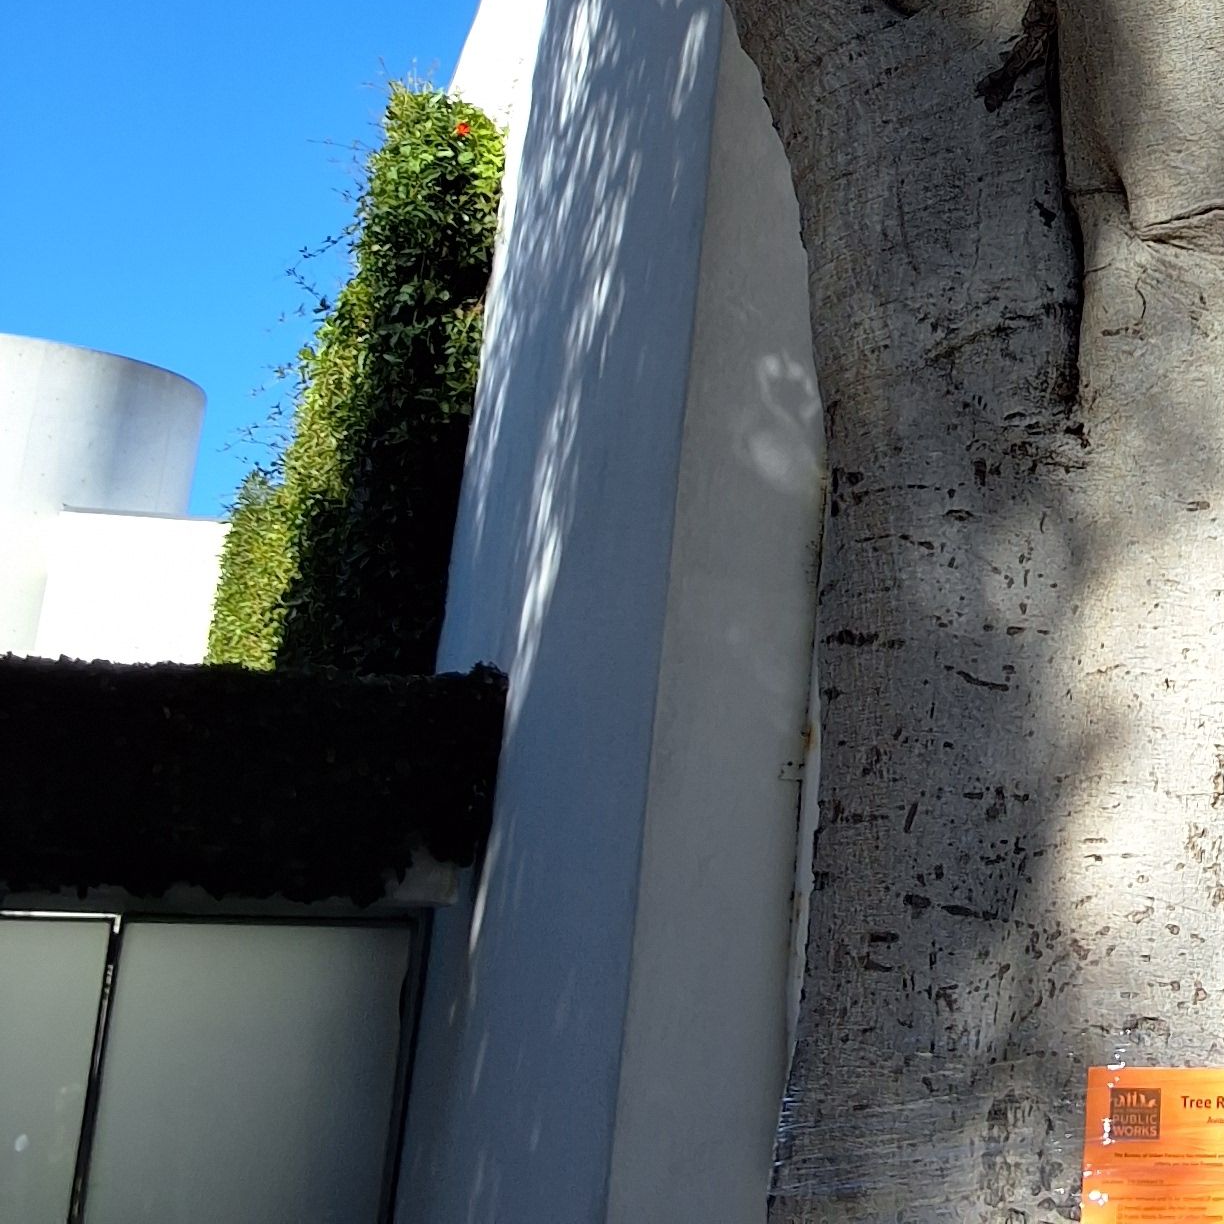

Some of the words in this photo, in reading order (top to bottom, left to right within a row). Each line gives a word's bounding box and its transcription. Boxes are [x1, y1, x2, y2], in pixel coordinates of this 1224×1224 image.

[1181, 1095, 1212, 1109] Tree
[1112, 1114, 1158, 1125] PUBLIC
[1112, 1125, 1158, 1137] WORKS
